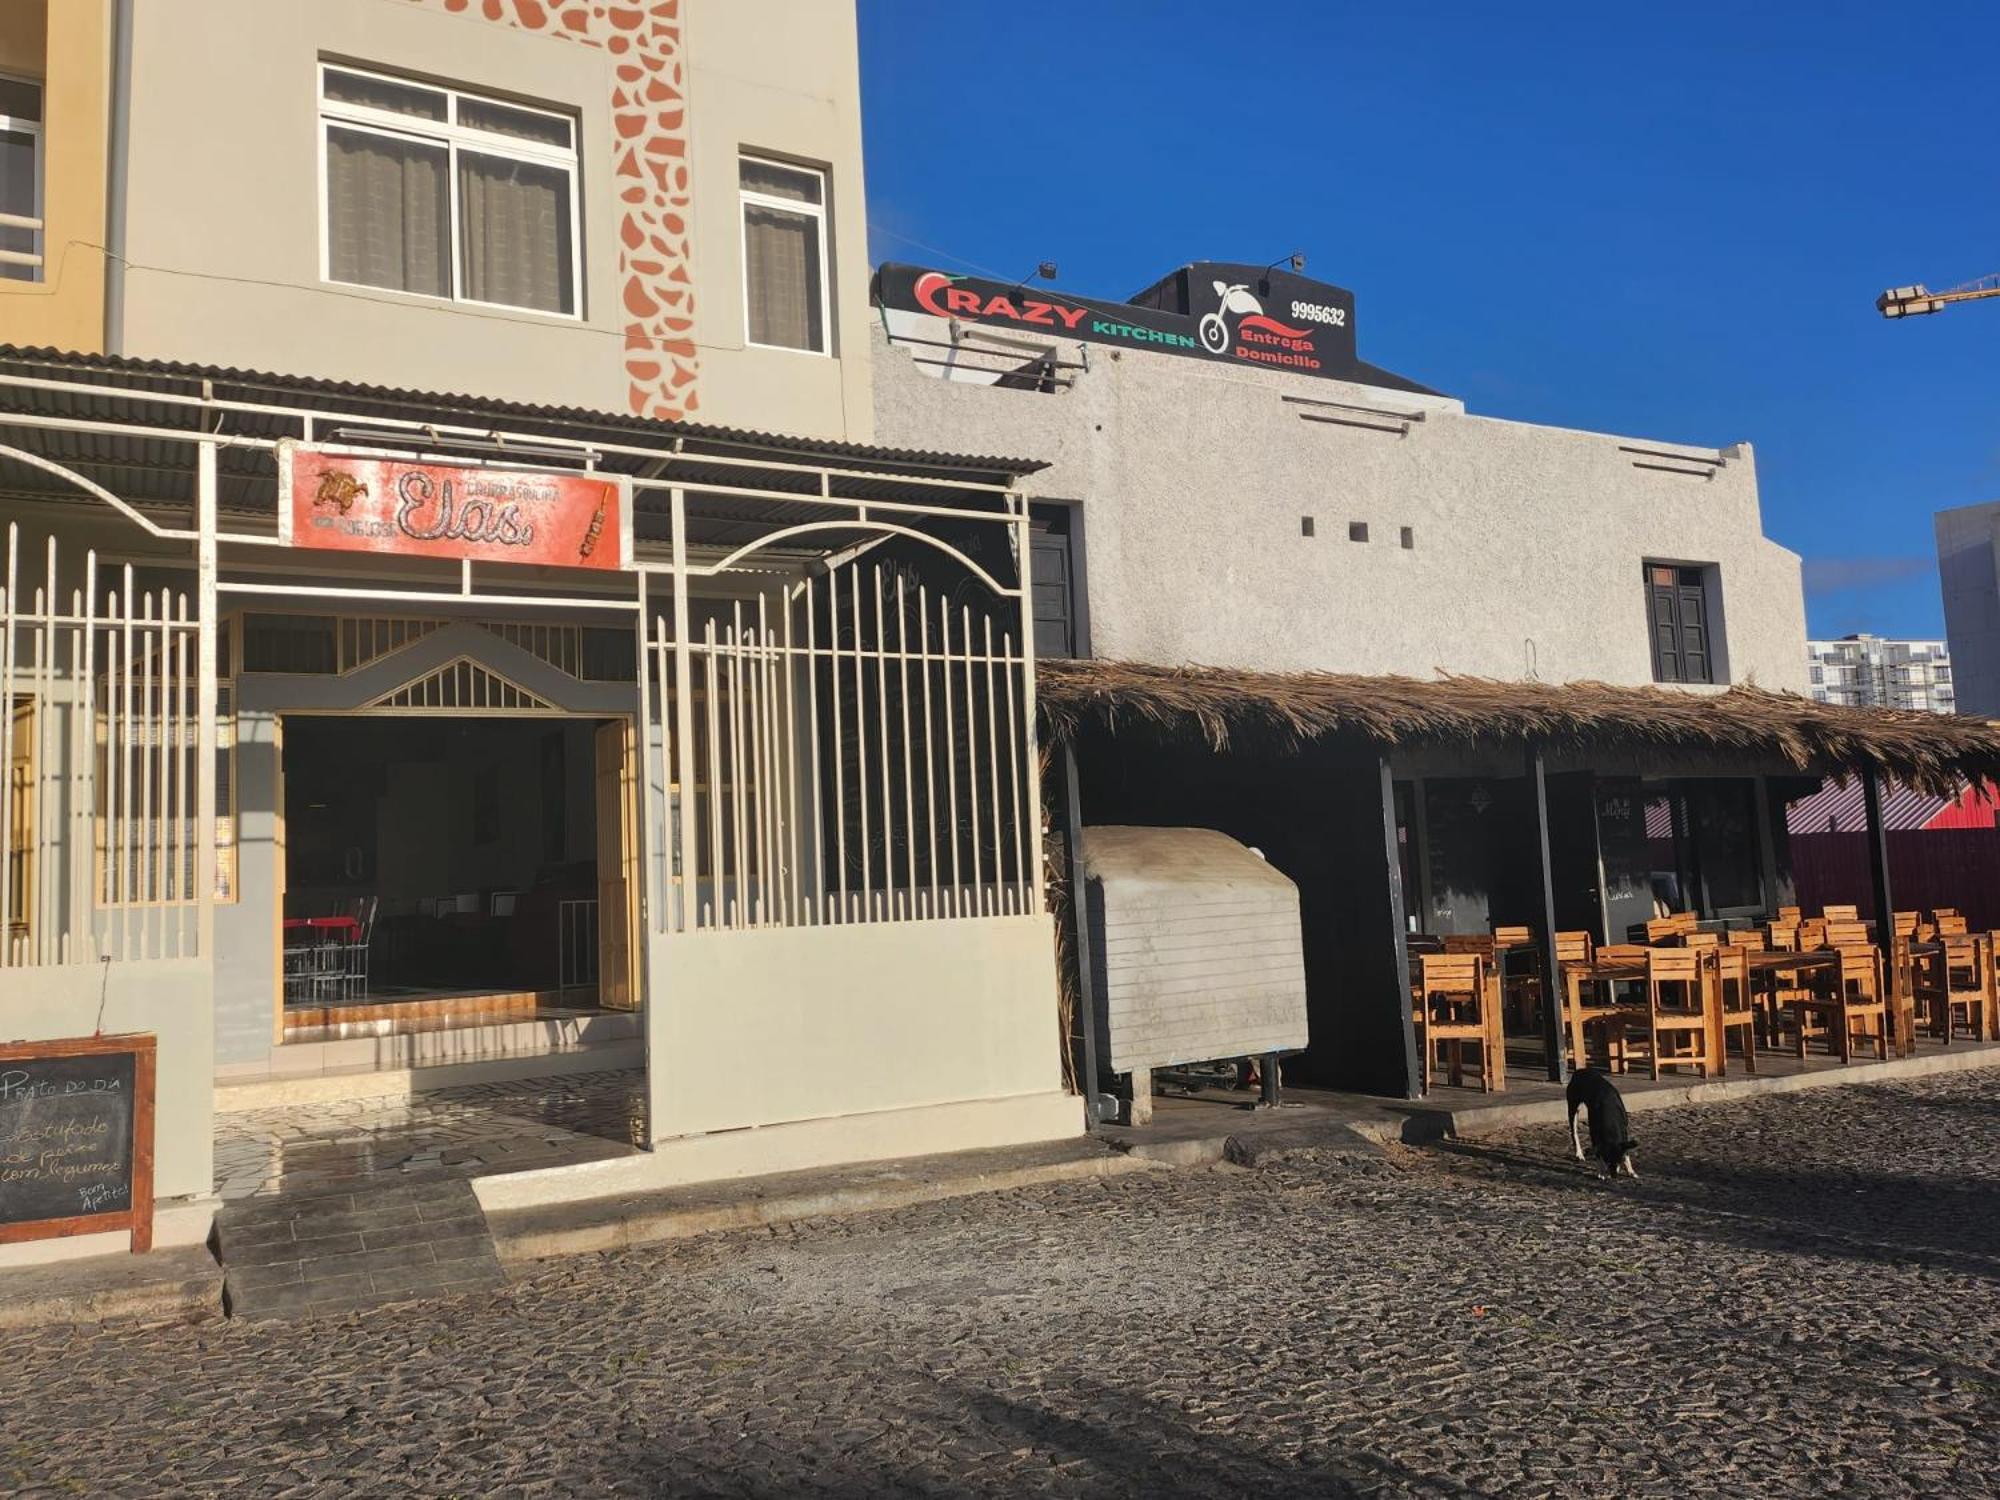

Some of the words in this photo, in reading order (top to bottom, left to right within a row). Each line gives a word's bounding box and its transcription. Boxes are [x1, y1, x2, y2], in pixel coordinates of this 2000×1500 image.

[914, 271, 1088, 329] CRAZY
[1092, 320, 1196, 349] KITCHEN
[1290, 300, 1346, 327] 9995632
[1240, 329, 1315, 352] Entrega
[1235, 345, 1321, 370] Domicilio
